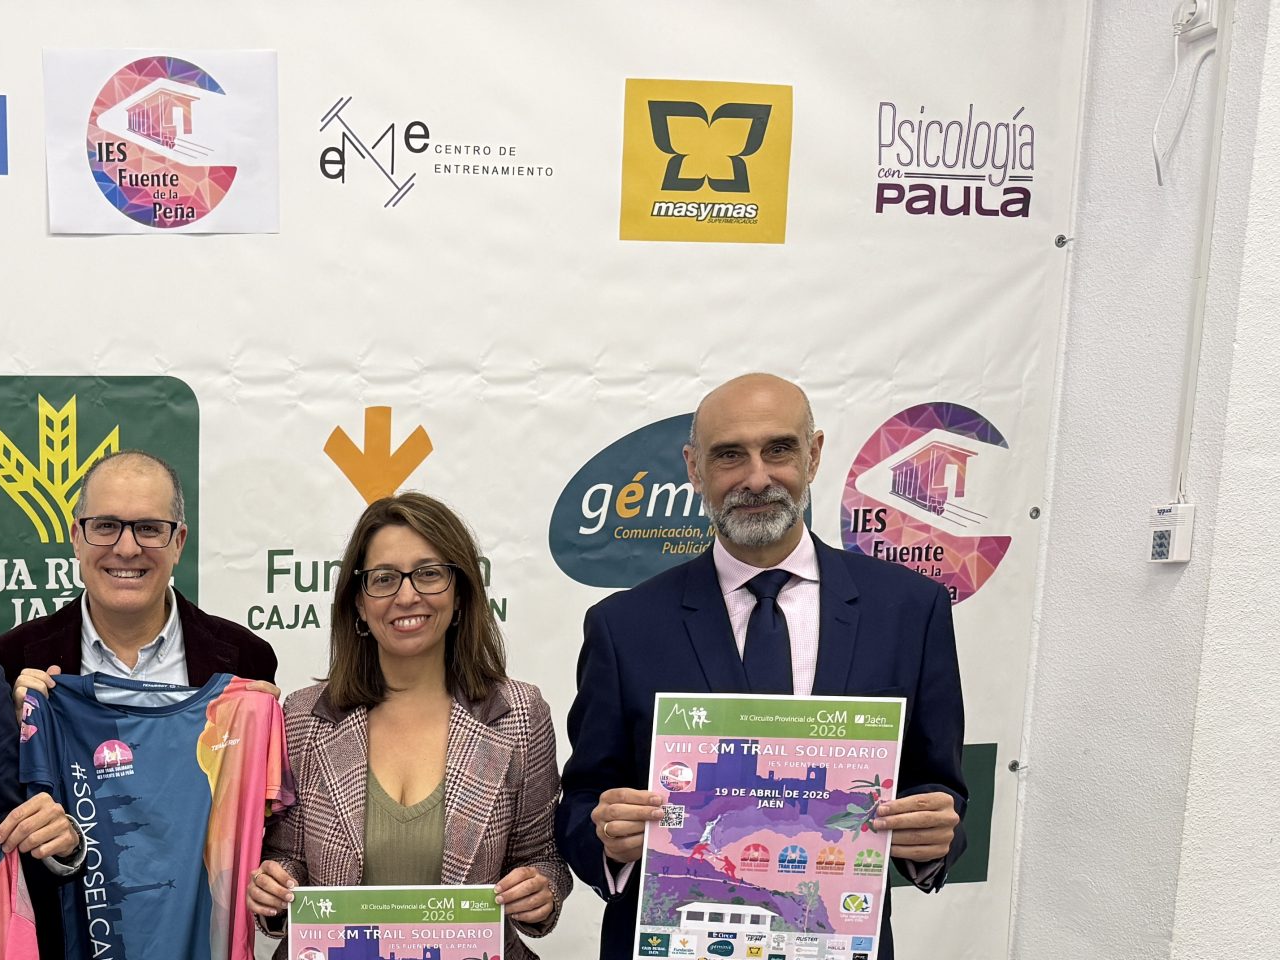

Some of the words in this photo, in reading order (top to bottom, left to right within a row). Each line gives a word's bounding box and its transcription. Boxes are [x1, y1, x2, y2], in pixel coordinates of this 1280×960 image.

[434, 144, 491, 156] CENTRO
[499, 146, 517, 157] DE
[878, 102, 1035, 187] Psicología
[97, 142, 127, 163] IES
[434, 164, 554, 177] ENTRENAMIENTO
[877, 168, 903, 179] con
[118, 168, 180, 188] Fuente
[153, 189, 166, 200] de
[168, 189, 179, 200] la
[153, 202, 196, 220] Peña
[651, 201, 759, 221] masymas
[852, 508, 888, 533] IES
[614, 526, 704, 540] Comunicación,
[662, 541, 710, 555] Publicid
[873, 541, 944, 563] Fuente
[931, 565, 942, 577] la
[247, 604, 321, 630] CAJA
[774, 715, 805, 723] Provincial
[816, 710, 847, 724] CxM
[809, 724, 846, 737] 2026
[664, 742, 692, 754] VIII
[698, 742, 734, 755] CXM
[741, 743, 789, 756] TRAIL
[795, 744, 888, 759] SOLIDARIO
[784, 761, 818, 769] FUENTE
[714, 787, 728, 797] 19
[731, 788, 746, 798] DE
[749, 788, 782, 798] ABRIL
[785, 789, 799, 798] DE
[802, 790, 830, 800] 2026
[756, 798, 784, 809] JAÉN
[368, 903, 391, 911] Circuito
[427, 898, 455, 910] CxM
[422, 910, 455, 922] 2026
[299, 929, 322, 940] VIII
[327, 929, 359, 940] CXM
[364, 929, 405, 940] TRAIL
[411, 928, 493, 940] SOLIDARIO
